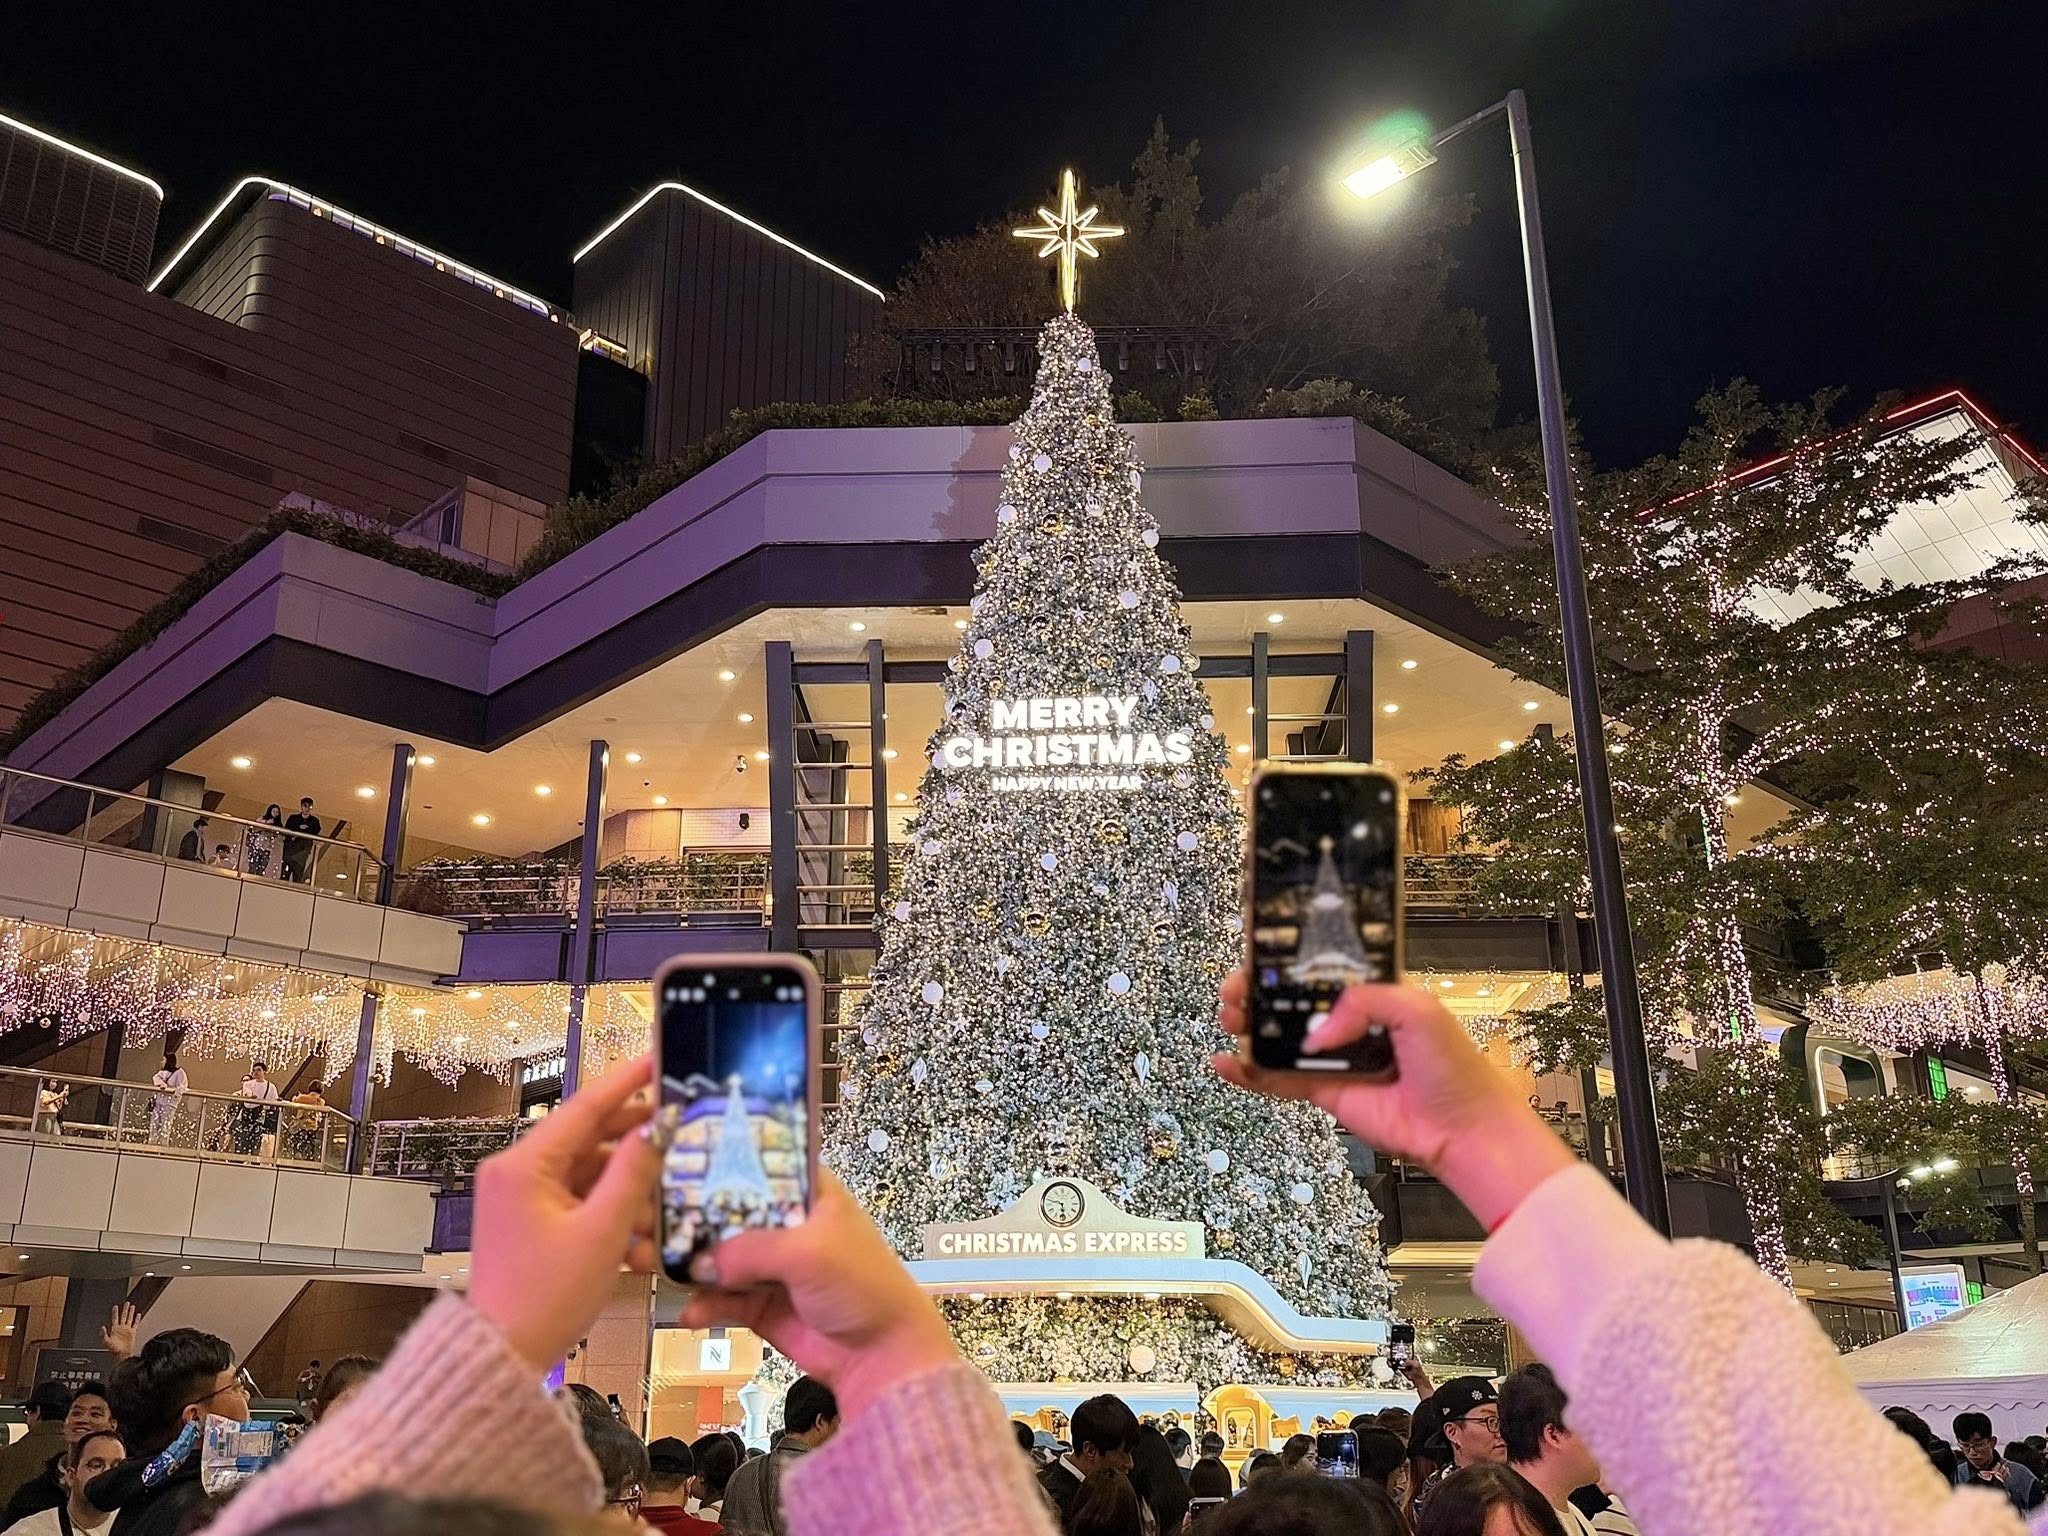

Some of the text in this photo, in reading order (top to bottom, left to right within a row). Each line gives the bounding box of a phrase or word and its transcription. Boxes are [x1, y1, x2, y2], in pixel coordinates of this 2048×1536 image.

[992, 696, 1139, 729] MERRY
[944, 732, 1193, 767] CHRISTMAS
[992, 775, 1143, 791] HAPPY NEW YEAR
[939, 1231, 1188, 1254] CHRISTMAS EXPRESS
